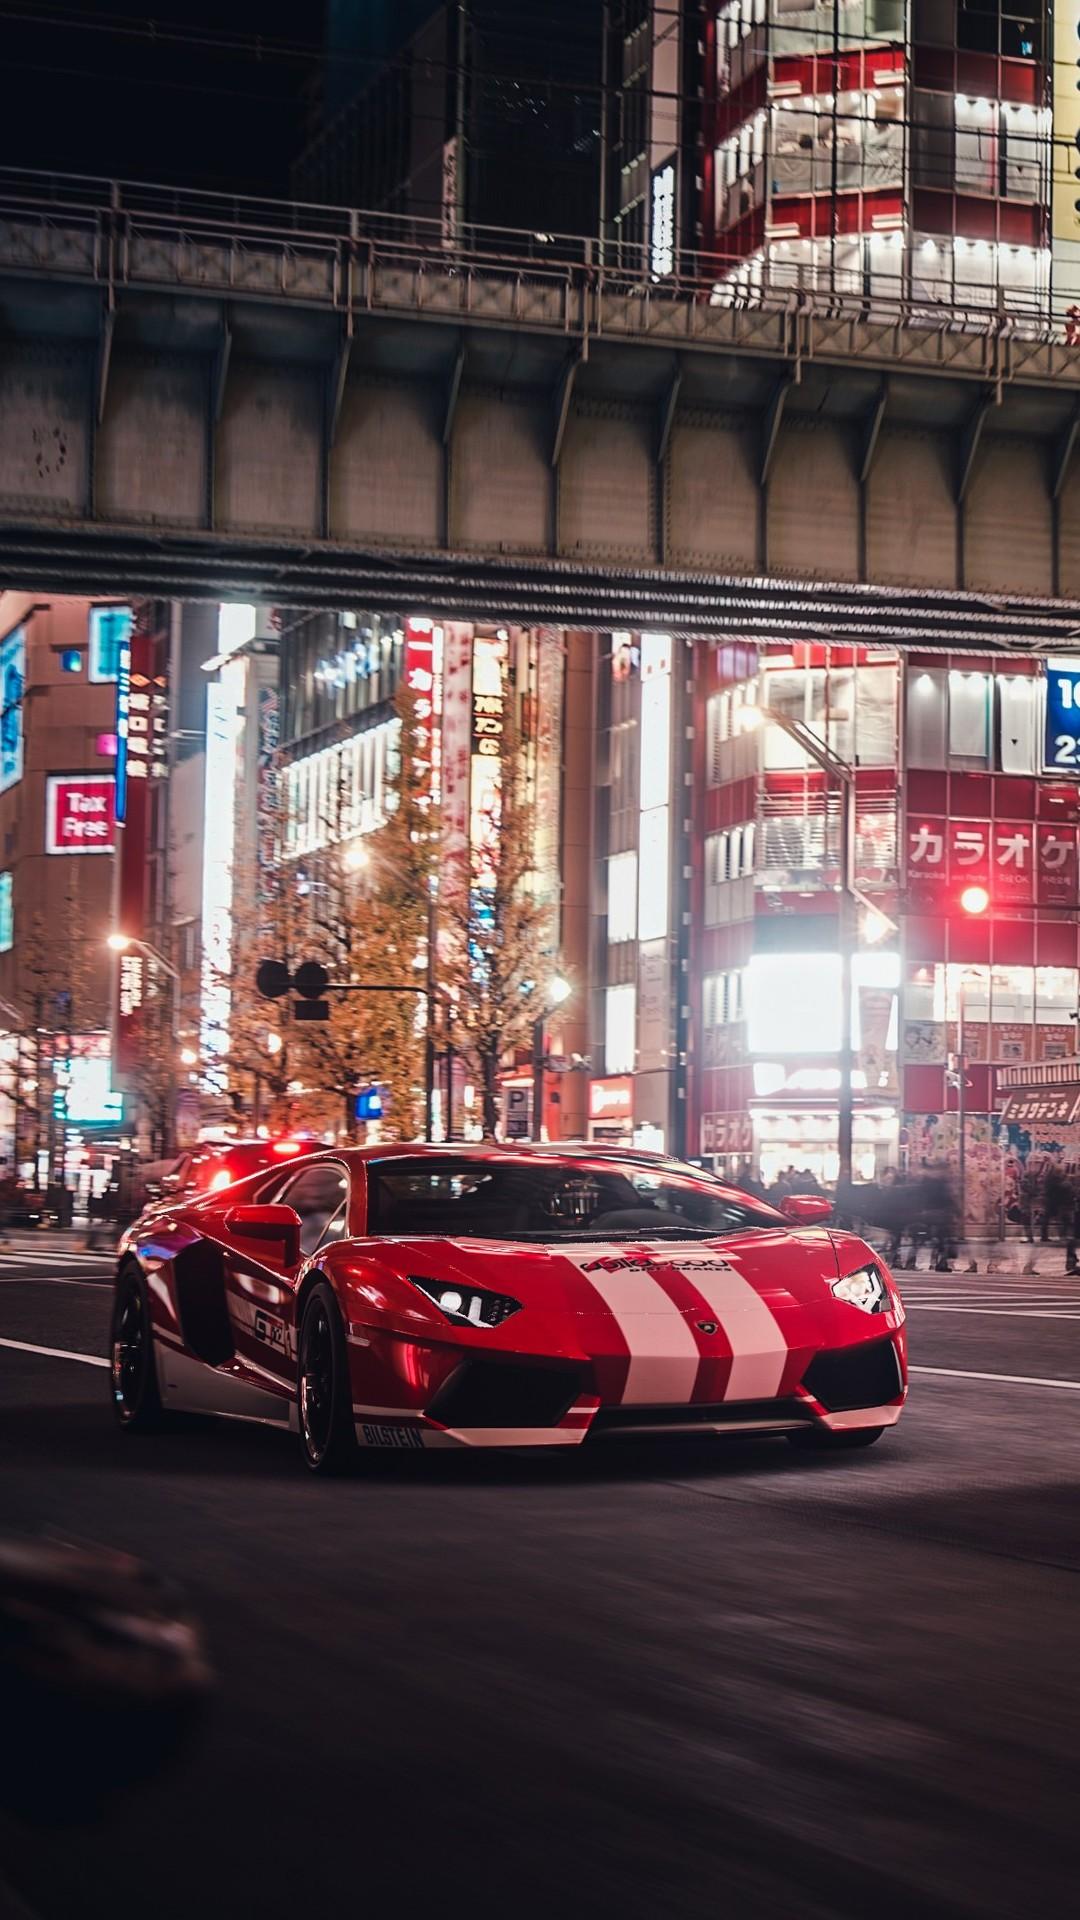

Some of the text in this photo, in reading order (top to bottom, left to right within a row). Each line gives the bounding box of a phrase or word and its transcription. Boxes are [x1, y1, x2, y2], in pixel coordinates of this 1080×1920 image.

[1054, 734, 1080, 764] 2
[66, 792, 107, 813] Tax
[62, 817, 108, 838] Free
[910, 826, 1074, 869] カラオケ
[508, 1090, 525, 1110] P
[362, 1424, 425, 1448] BILSTEIN
